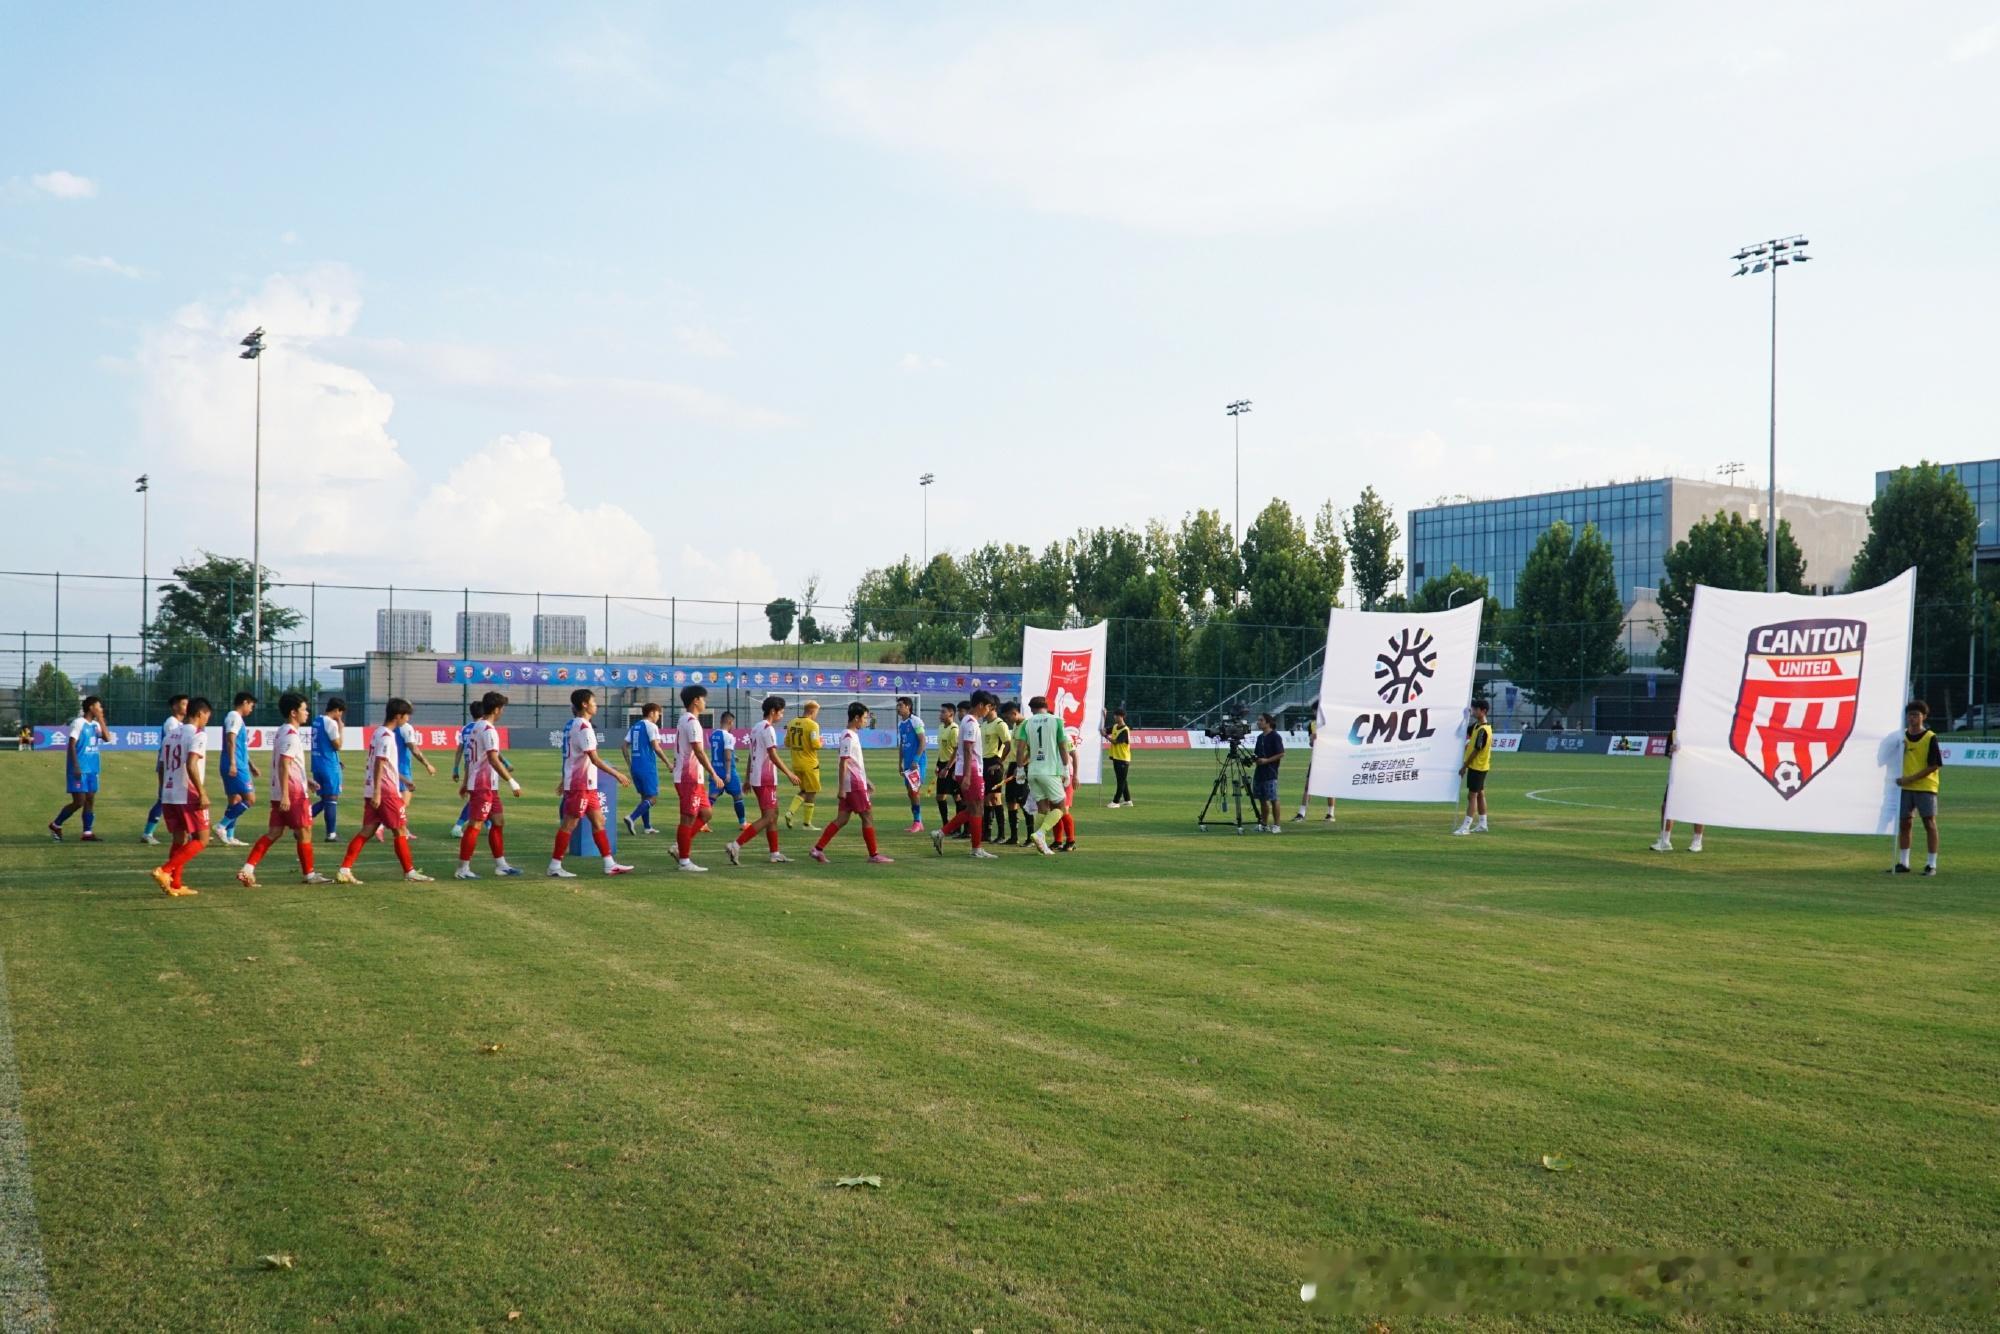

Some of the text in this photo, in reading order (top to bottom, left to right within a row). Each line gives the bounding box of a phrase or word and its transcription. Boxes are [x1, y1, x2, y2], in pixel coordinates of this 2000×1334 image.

[1757, 625, 1860, 653] CANTON
[1779, 661, 1831, 675] UNITED
[790, 726, 804, 750] 77
[1036, 725, 1043, 749] 1
[1348, 708, 1436, 746] CMCL
[1361, 757, 1415, 771] 中国足球协会
[1352, 769, 1420, 786] 会员协会冠军联赛
